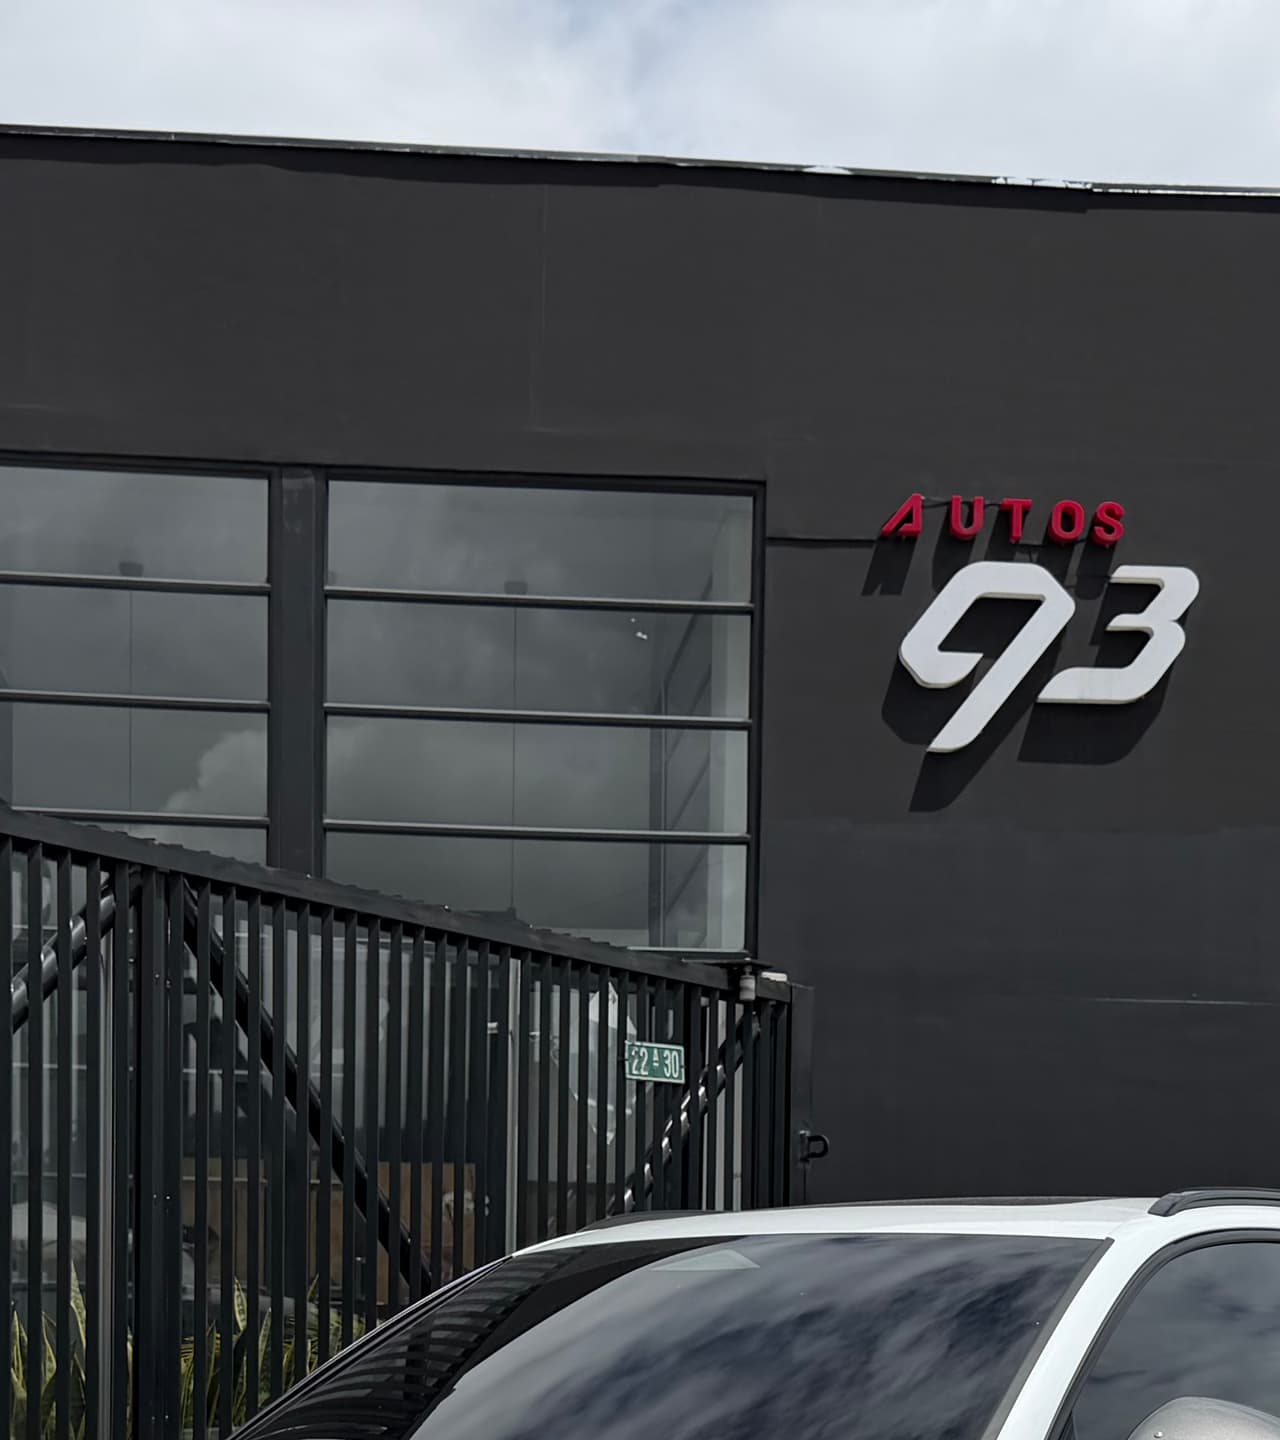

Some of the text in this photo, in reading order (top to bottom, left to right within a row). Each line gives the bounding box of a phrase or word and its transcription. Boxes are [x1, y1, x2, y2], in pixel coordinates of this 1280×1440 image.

[880, 493, 1125, 547] AUTOS
[898, 561, 1200, 753] 93
[631, 1046, 649, 1075] 22
[663, 1049, 680, 1078] 30
